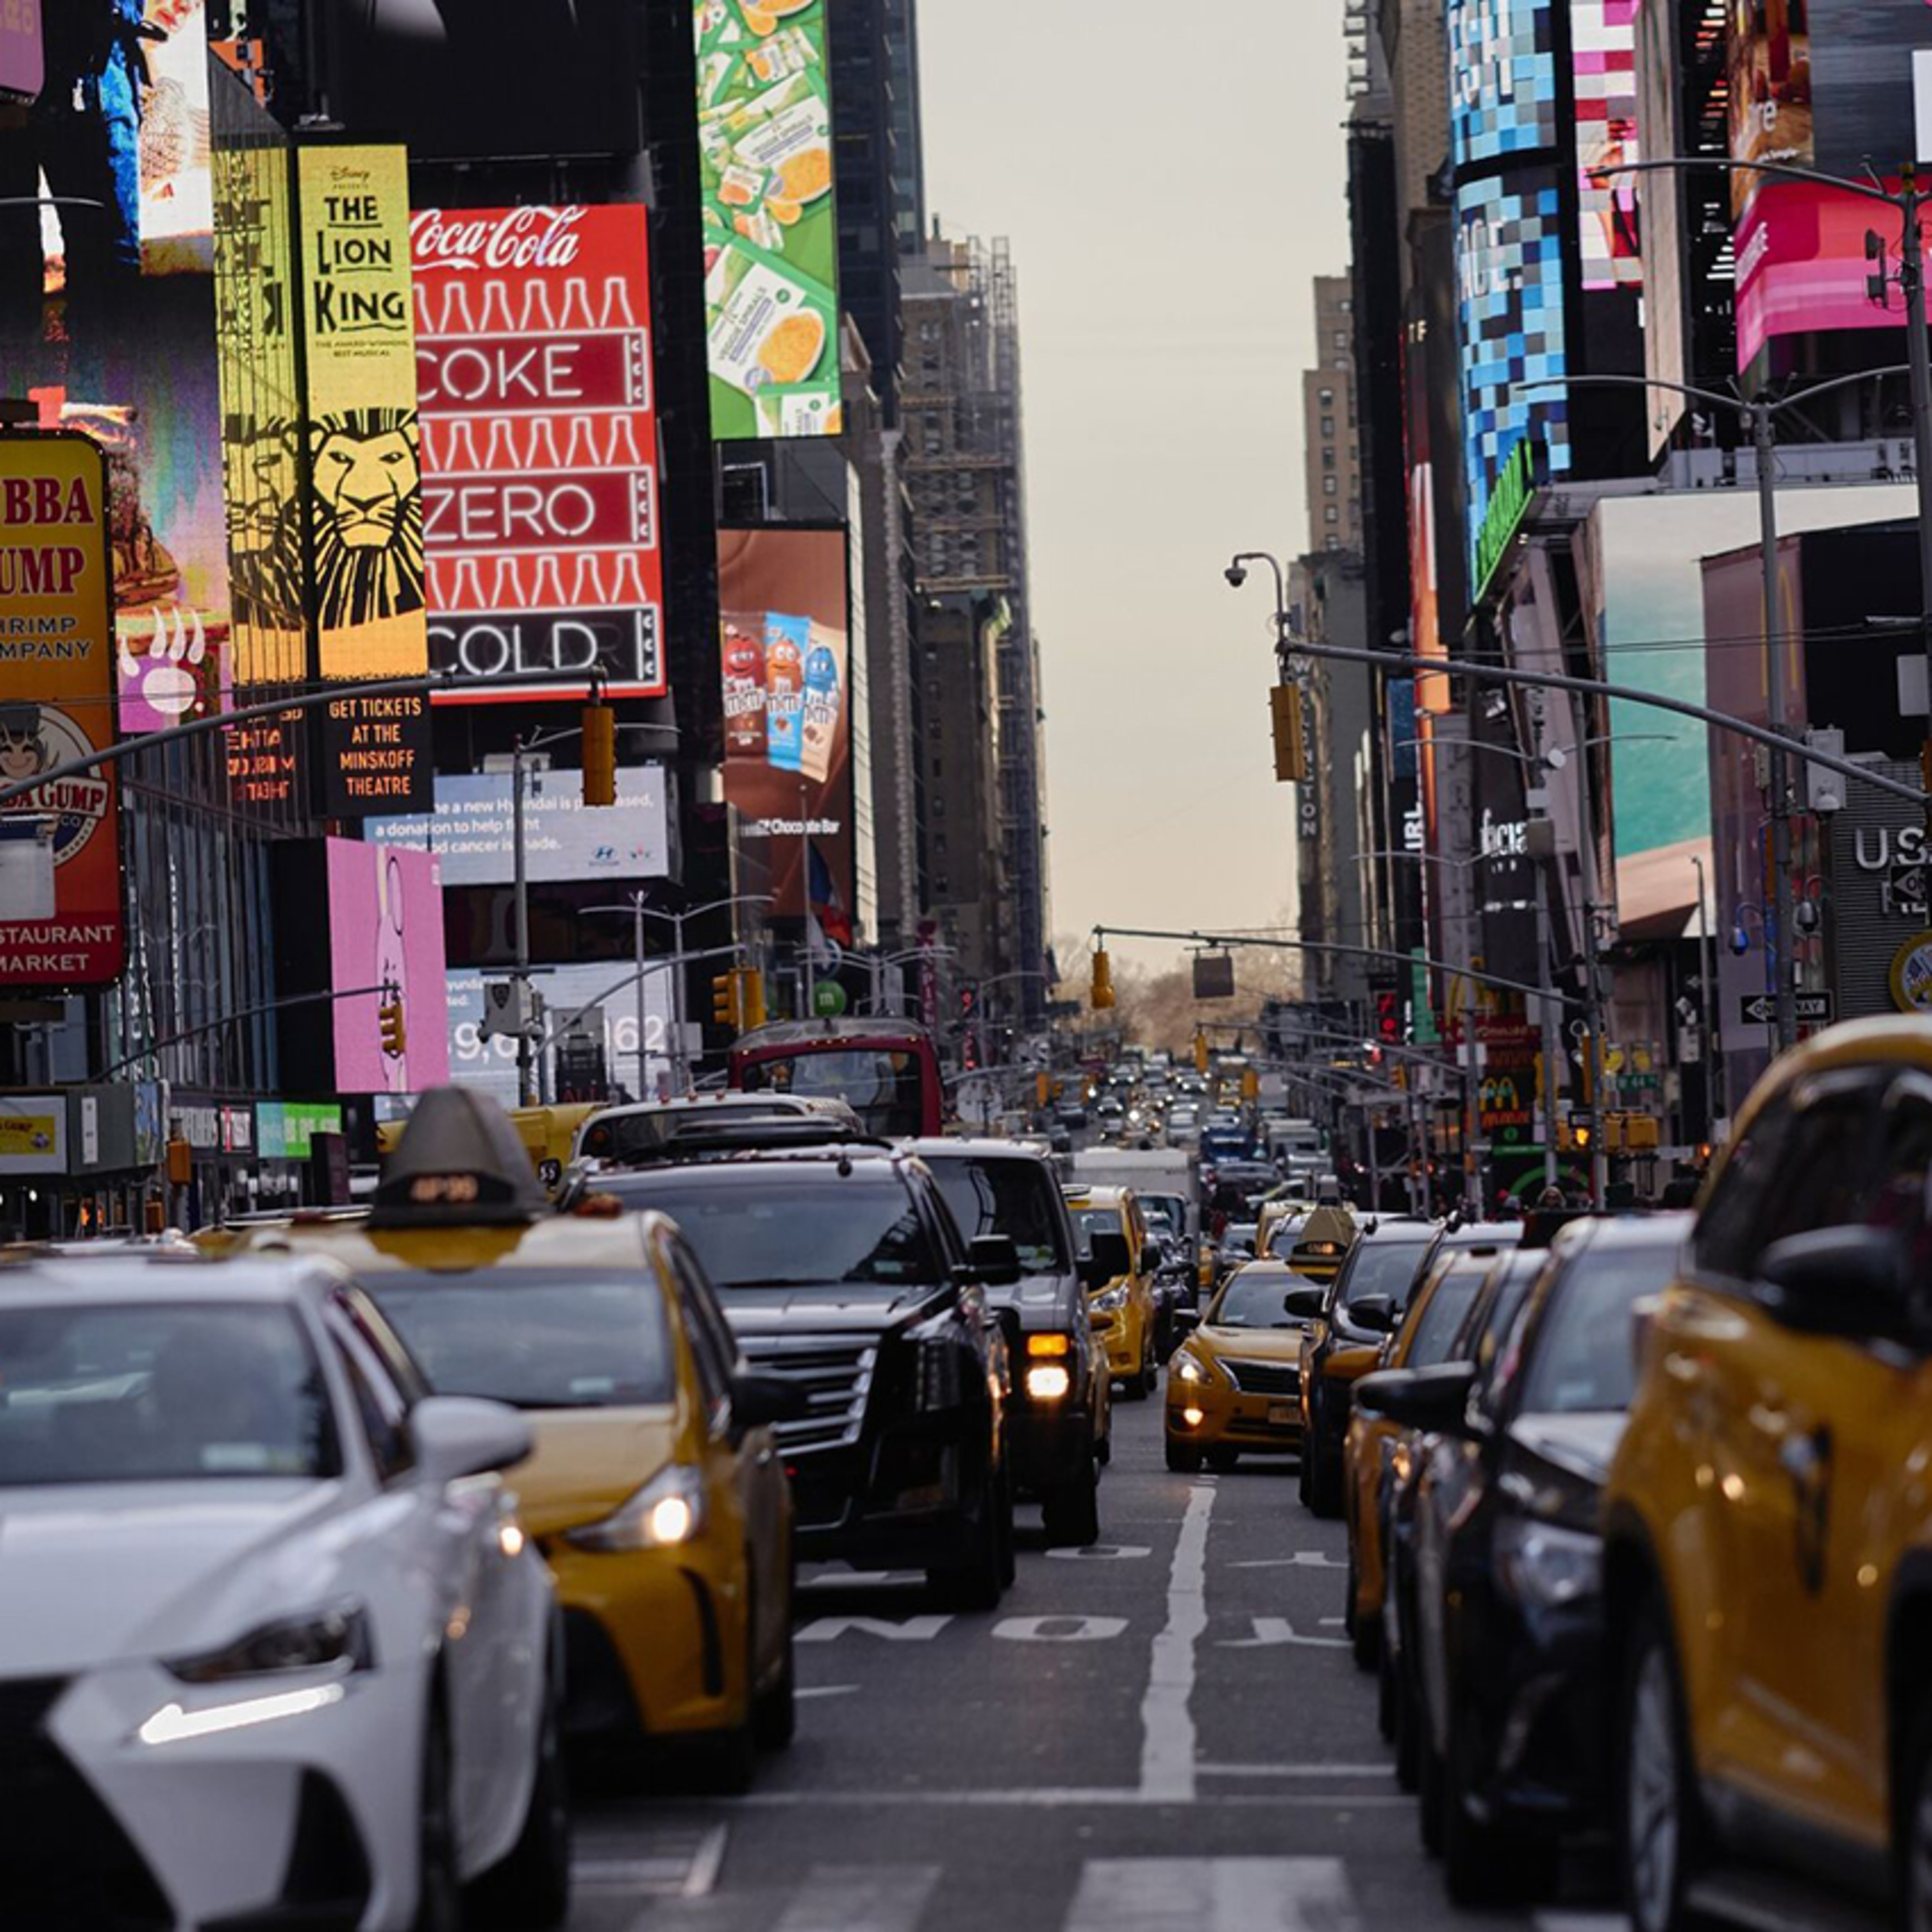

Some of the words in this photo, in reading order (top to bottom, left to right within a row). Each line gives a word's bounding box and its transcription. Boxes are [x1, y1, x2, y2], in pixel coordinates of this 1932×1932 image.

[324, 195, 378, 221] THE
[317, 230, 392, 276] LION
[314, 280, 405, 334] KING
[4, 477, 94, 524] BBA
[422, 484, 596, 541] ZERO
[329, 699, 357, 719] GET
[361, 697, 422, 717] TICKETS
[352, 724, 370, 744] AT
[373, 724, 401, 744] THE
[339, 750, 415, 770] MINSKOFF
[346, 775, 412, 796] THEATRE
[37, 782, 105, 812] GUMP
[464, 800, 495, 813] new
[61, 815, 81, 828] CO
[375, 824, 385, 837] a
[387, 819, 452, 837] donation
[454, 819, 469, 832] to
[472, 817, 504, 835] help
[451, 842, 498, 853] cancer
